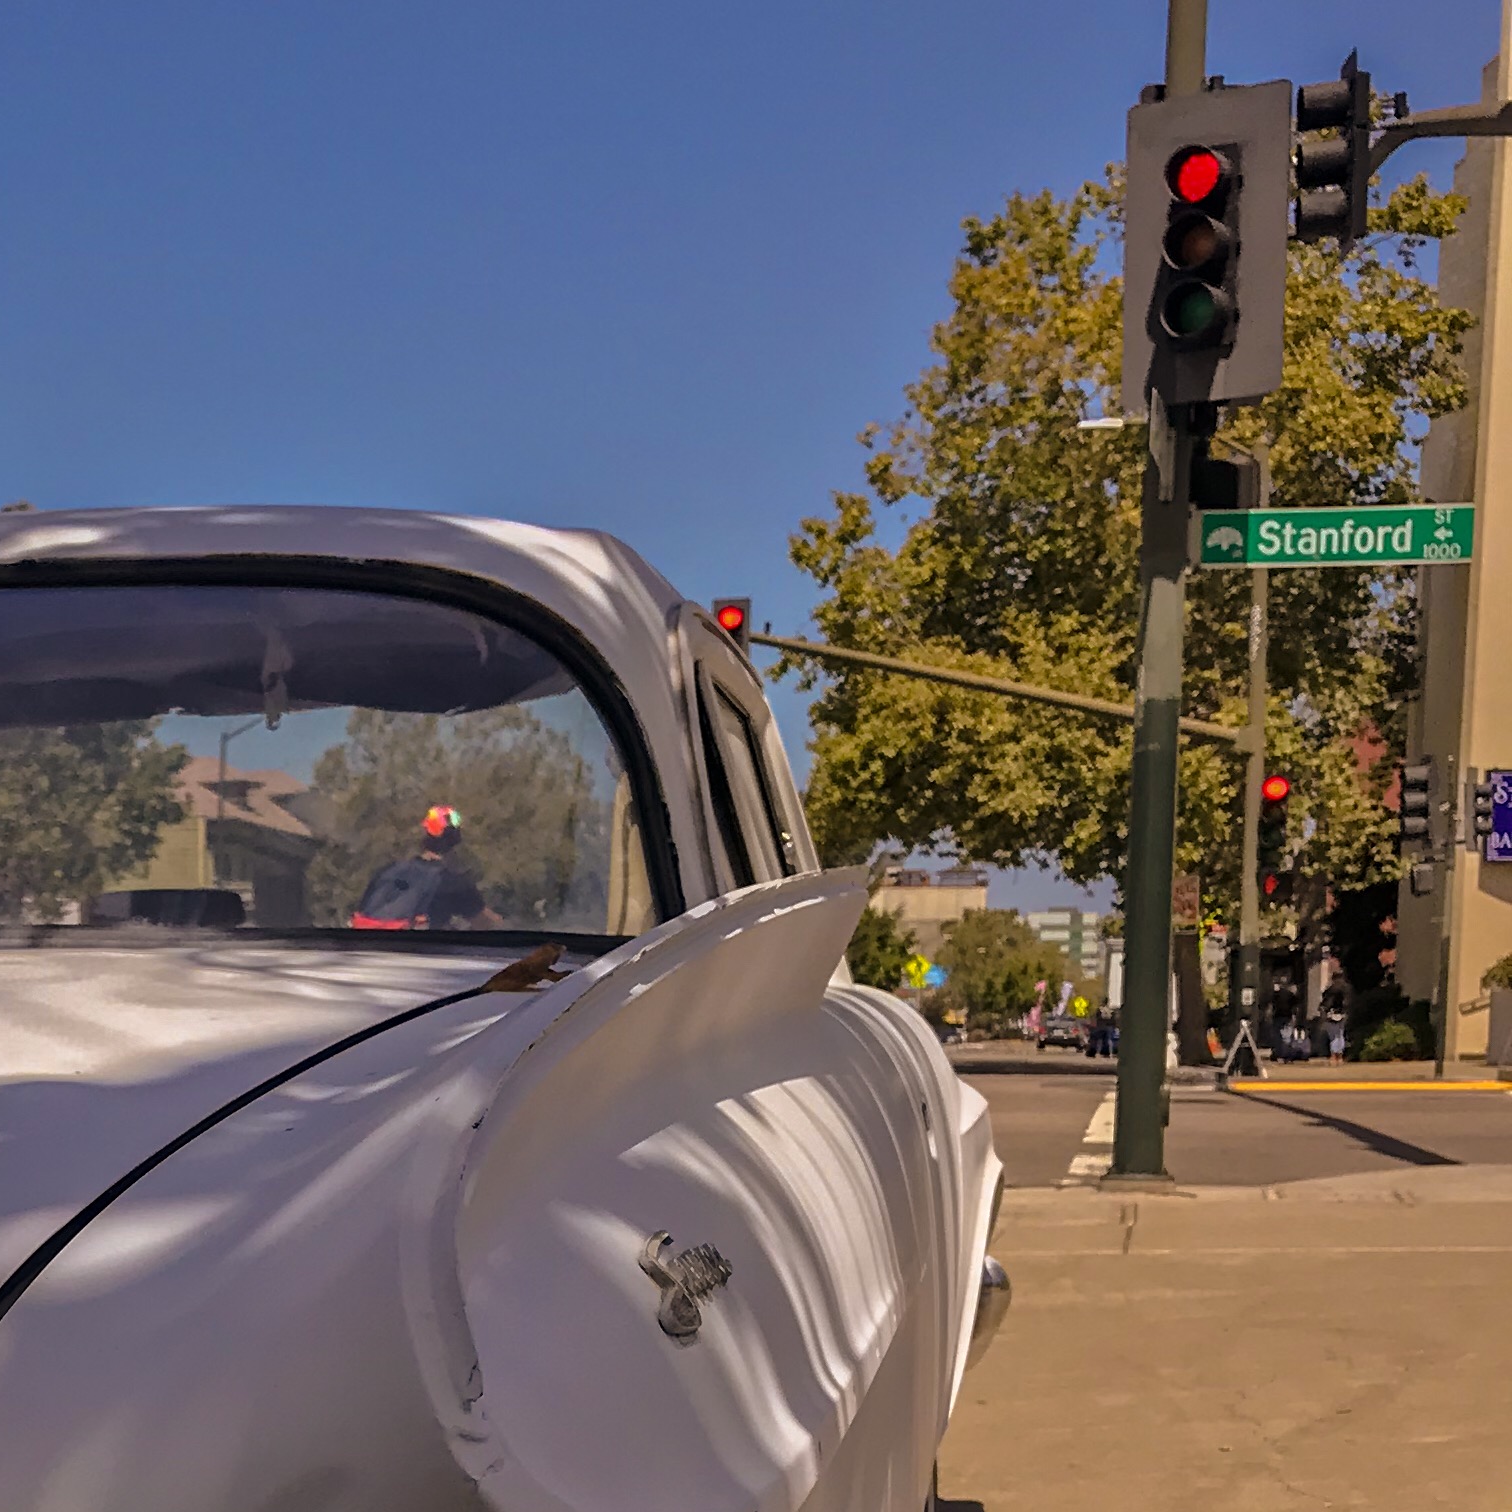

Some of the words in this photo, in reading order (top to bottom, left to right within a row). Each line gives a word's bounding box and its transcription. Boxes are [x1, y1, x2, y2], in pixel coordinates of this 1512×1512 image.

[1433, 509, 1455, 525] ST
[1257, 518, 1413, 556] Stanford
[1423, 543, 1462, 560] 1000
